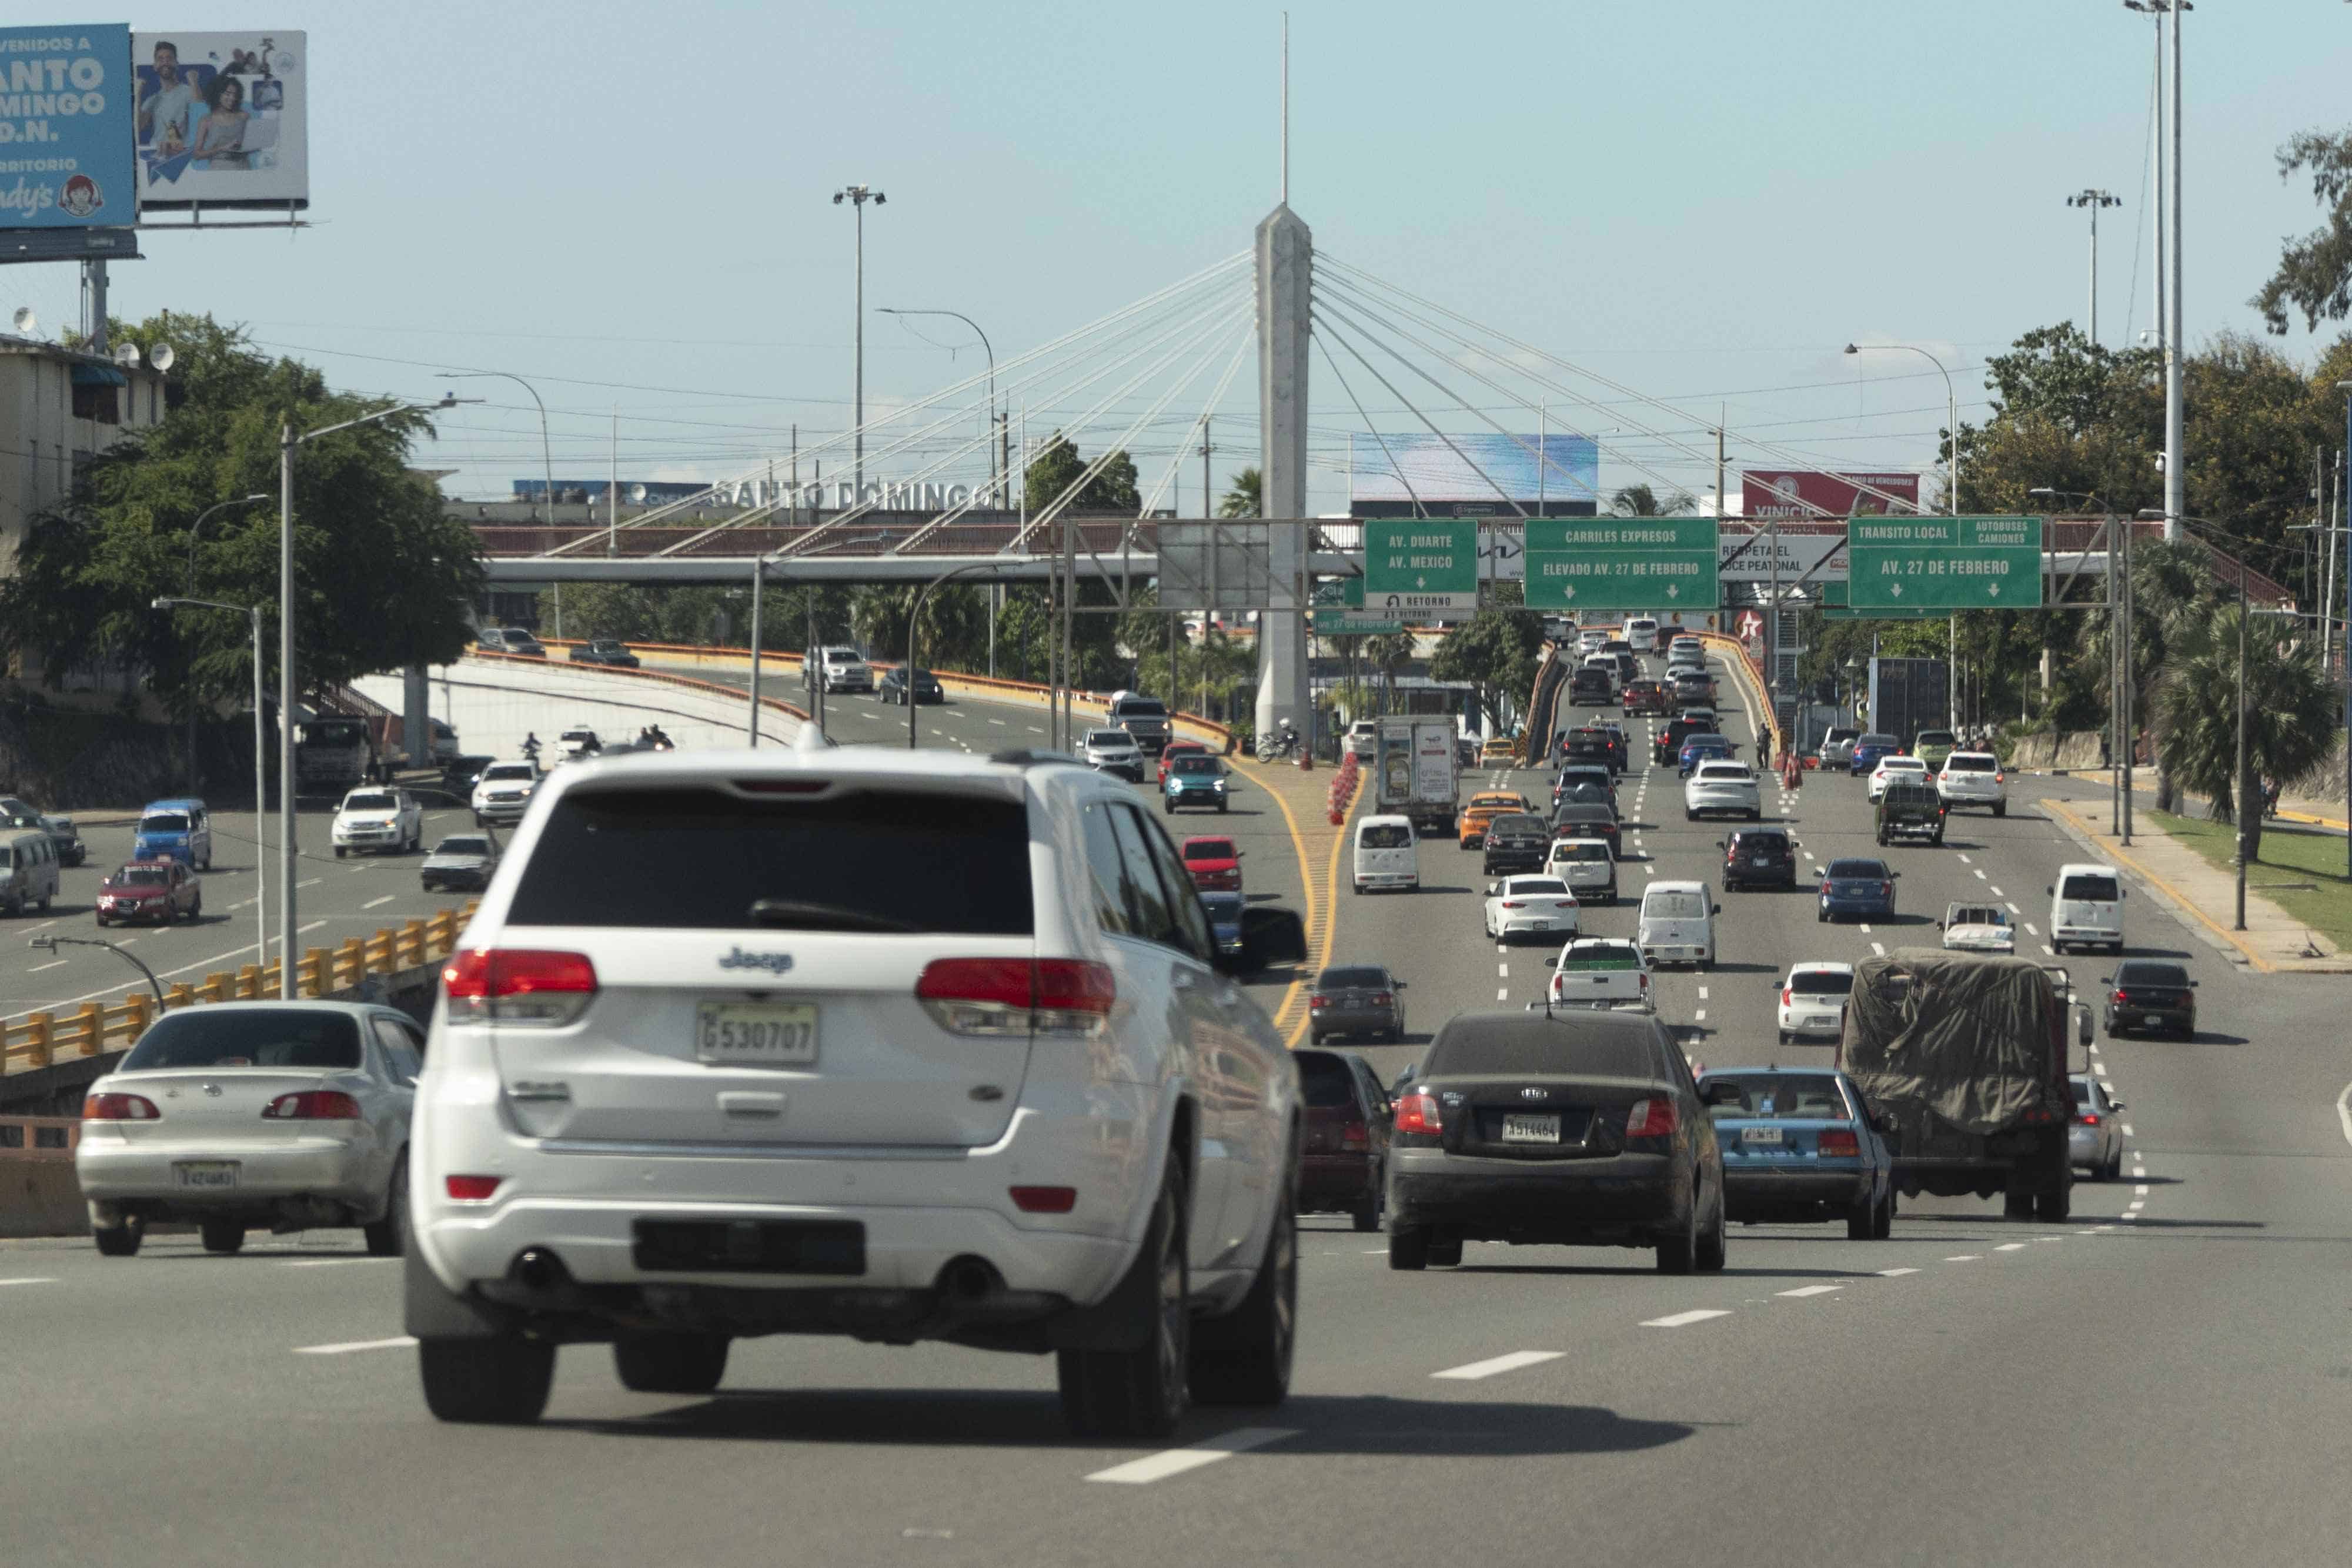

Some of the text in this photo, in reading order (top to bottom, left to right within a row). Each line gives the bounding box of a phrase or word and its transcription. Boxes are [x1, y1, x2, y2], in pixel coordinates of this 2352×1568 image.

[78, 38, 92, 51] A
[711, 480, 824, 509] SANTO
[835, 481, 1000, 511] DOMINGO
[1976, 521, 2028, 531] AUTOBUSES
[1565, 530, 1676, 543] CARRILES EXPRESOS
[1859, 527, 1948, 539] TRANSITO LOCAL
[1978, 533, 2025, 543] CAMIONES
[1389, 536, 1452, 547] AV. DUARTE
[1722, 546, 1790, 556] REPETA EL
[1389, 556, 1452, 569] AV. MEXICO
[1882, 561, 2009, 574] AV. 27 DE FEBRERO
[1543, 563, 1699, 576] ELEVADO AV. 27 DE FEBRERO
[1406, 597, 1451, 606] RETORNO
